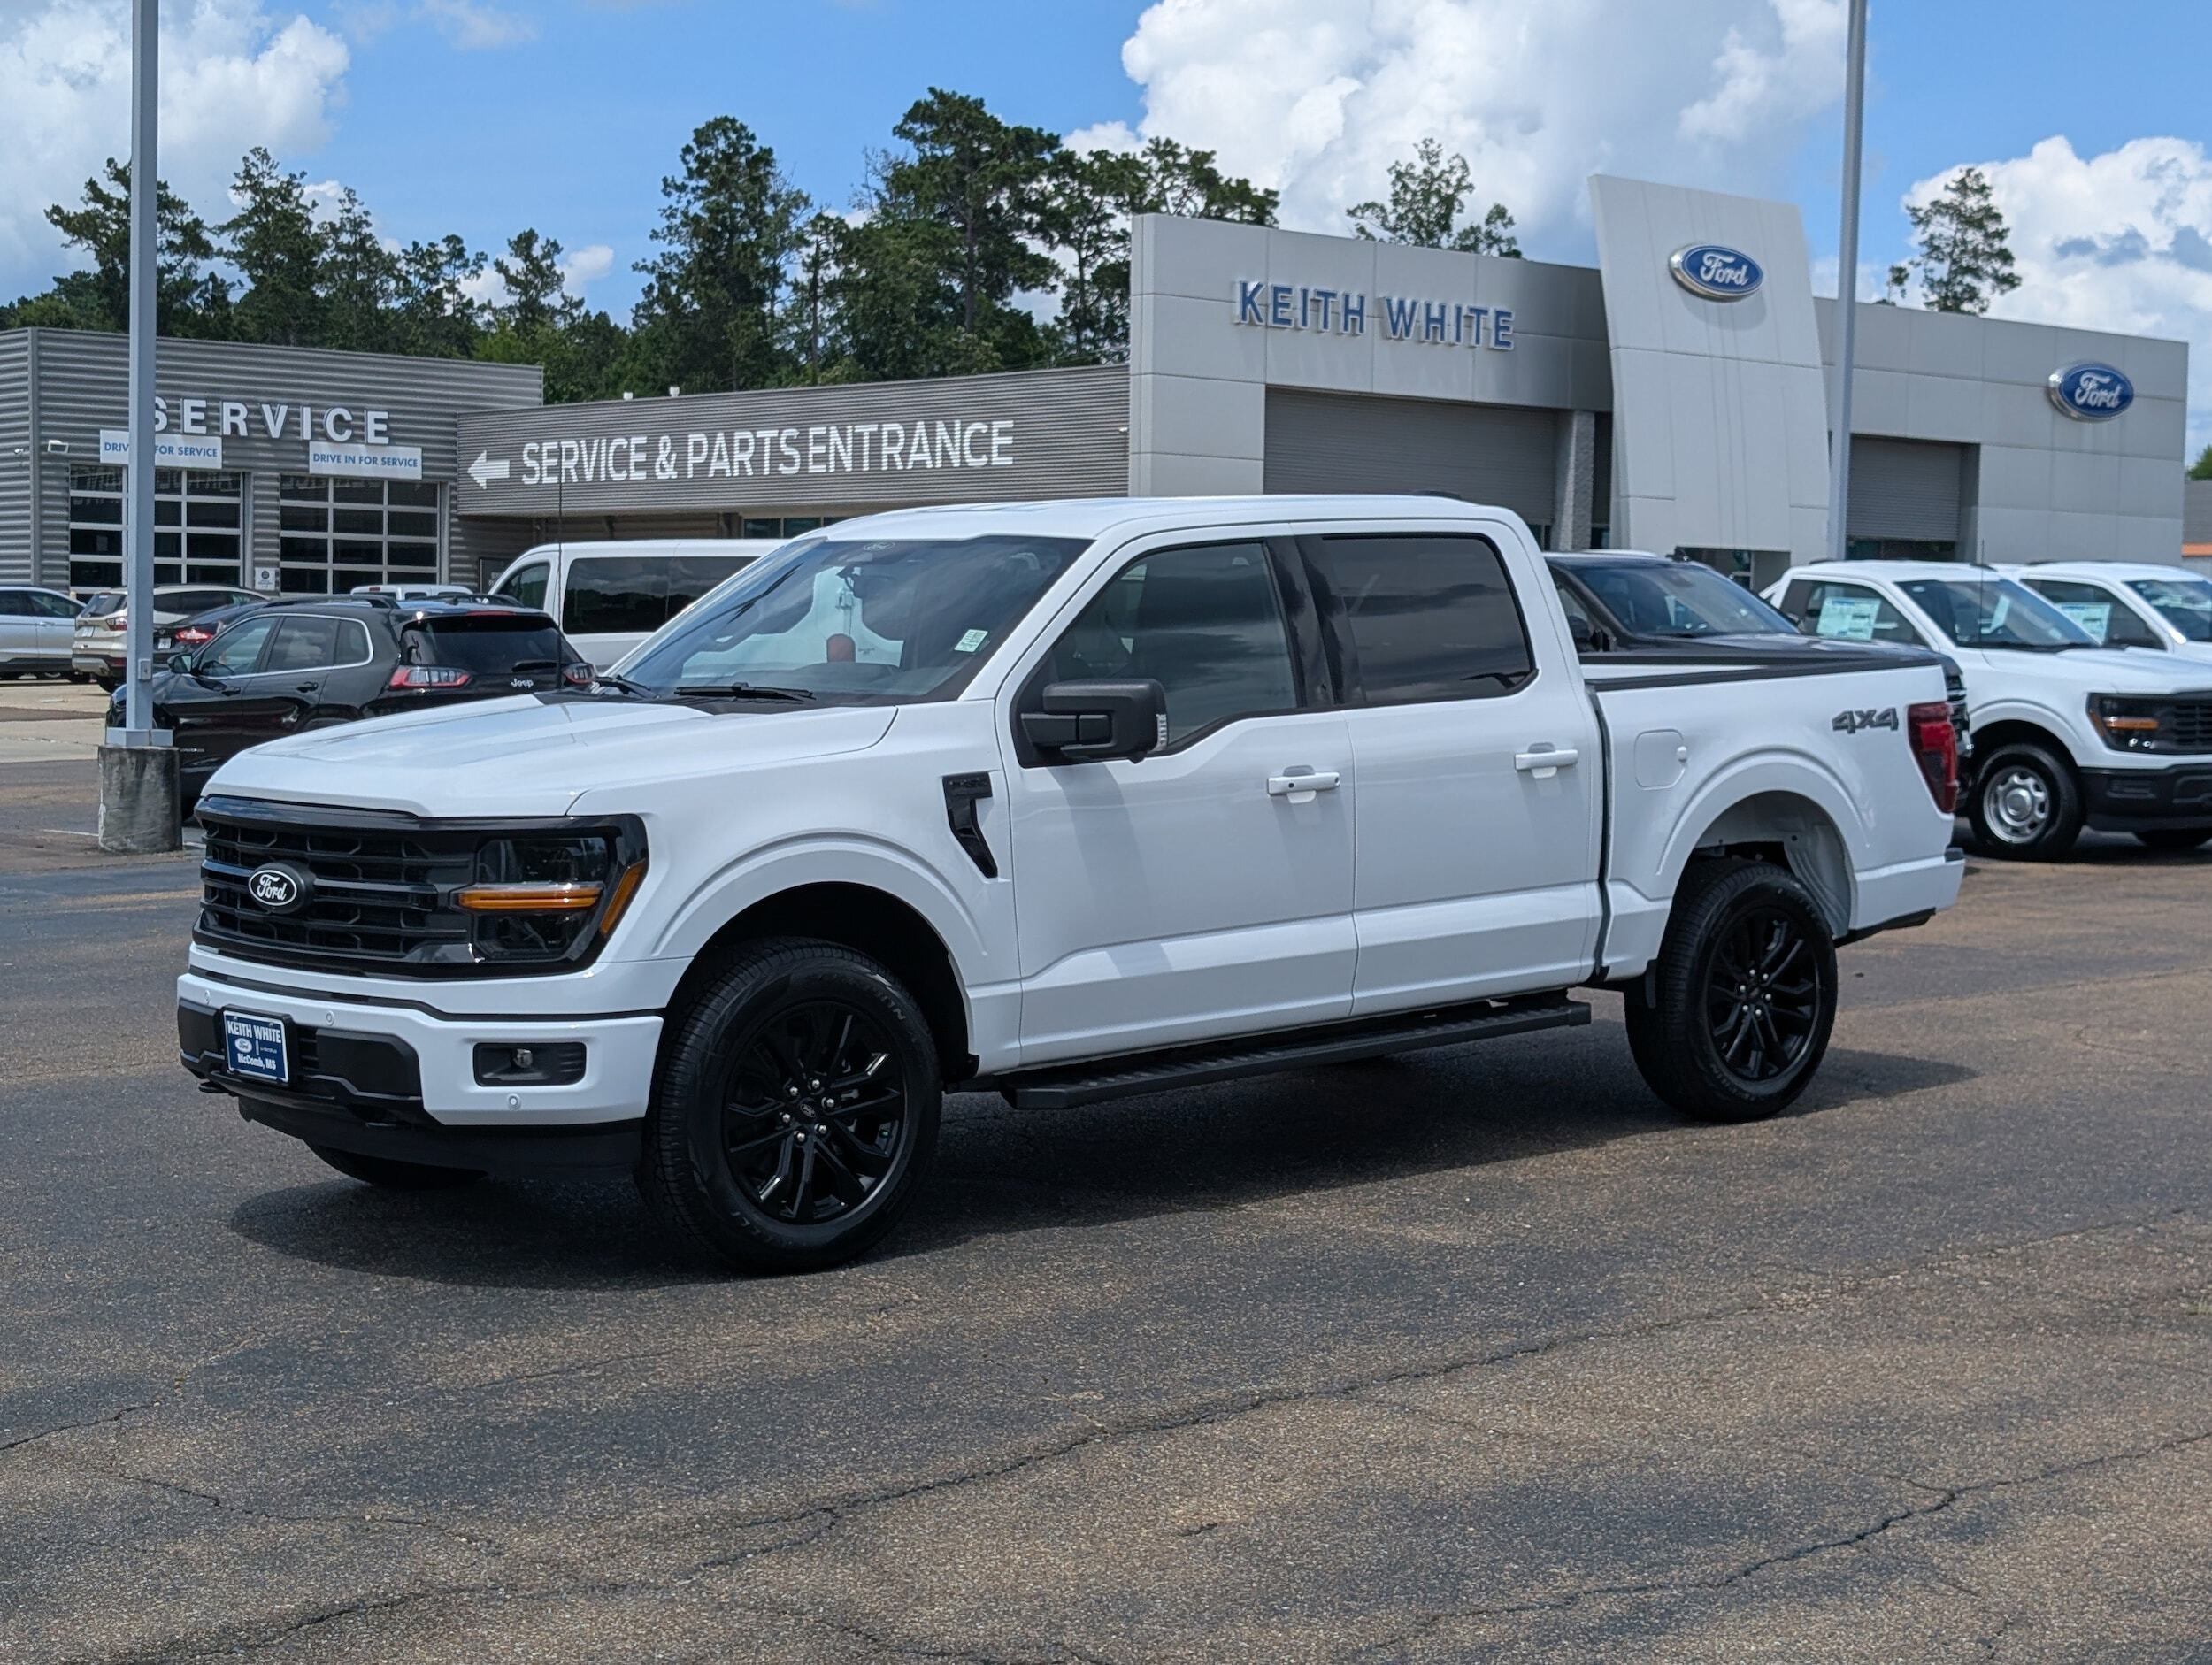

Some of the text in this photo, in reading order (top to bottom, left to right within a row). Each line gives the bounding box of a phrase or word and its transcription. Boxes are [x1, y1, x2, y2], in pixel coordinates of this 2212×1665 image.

[1700, 251, 1748, 286] Ford
[1235, 280, 1515, 350] KEITH WHITE
[2074, 372, 2123, 408] Ford
[104, 441, 130, 452] DRIV
[178, 447, 218, 457] SERVICE
[313, 453, 419, 468] DRIVE IN FOR SERVICE
[520, 419, 1015, 485] SERVICE & PARTS ENTRANCE
[510, 678, 534, 688] Jeep
[257, 873, 288, 901] Ford
[227, 1021, 281, 1043] KEITH WHITE
[237, 1053, 276, 1070] McComb, MS
